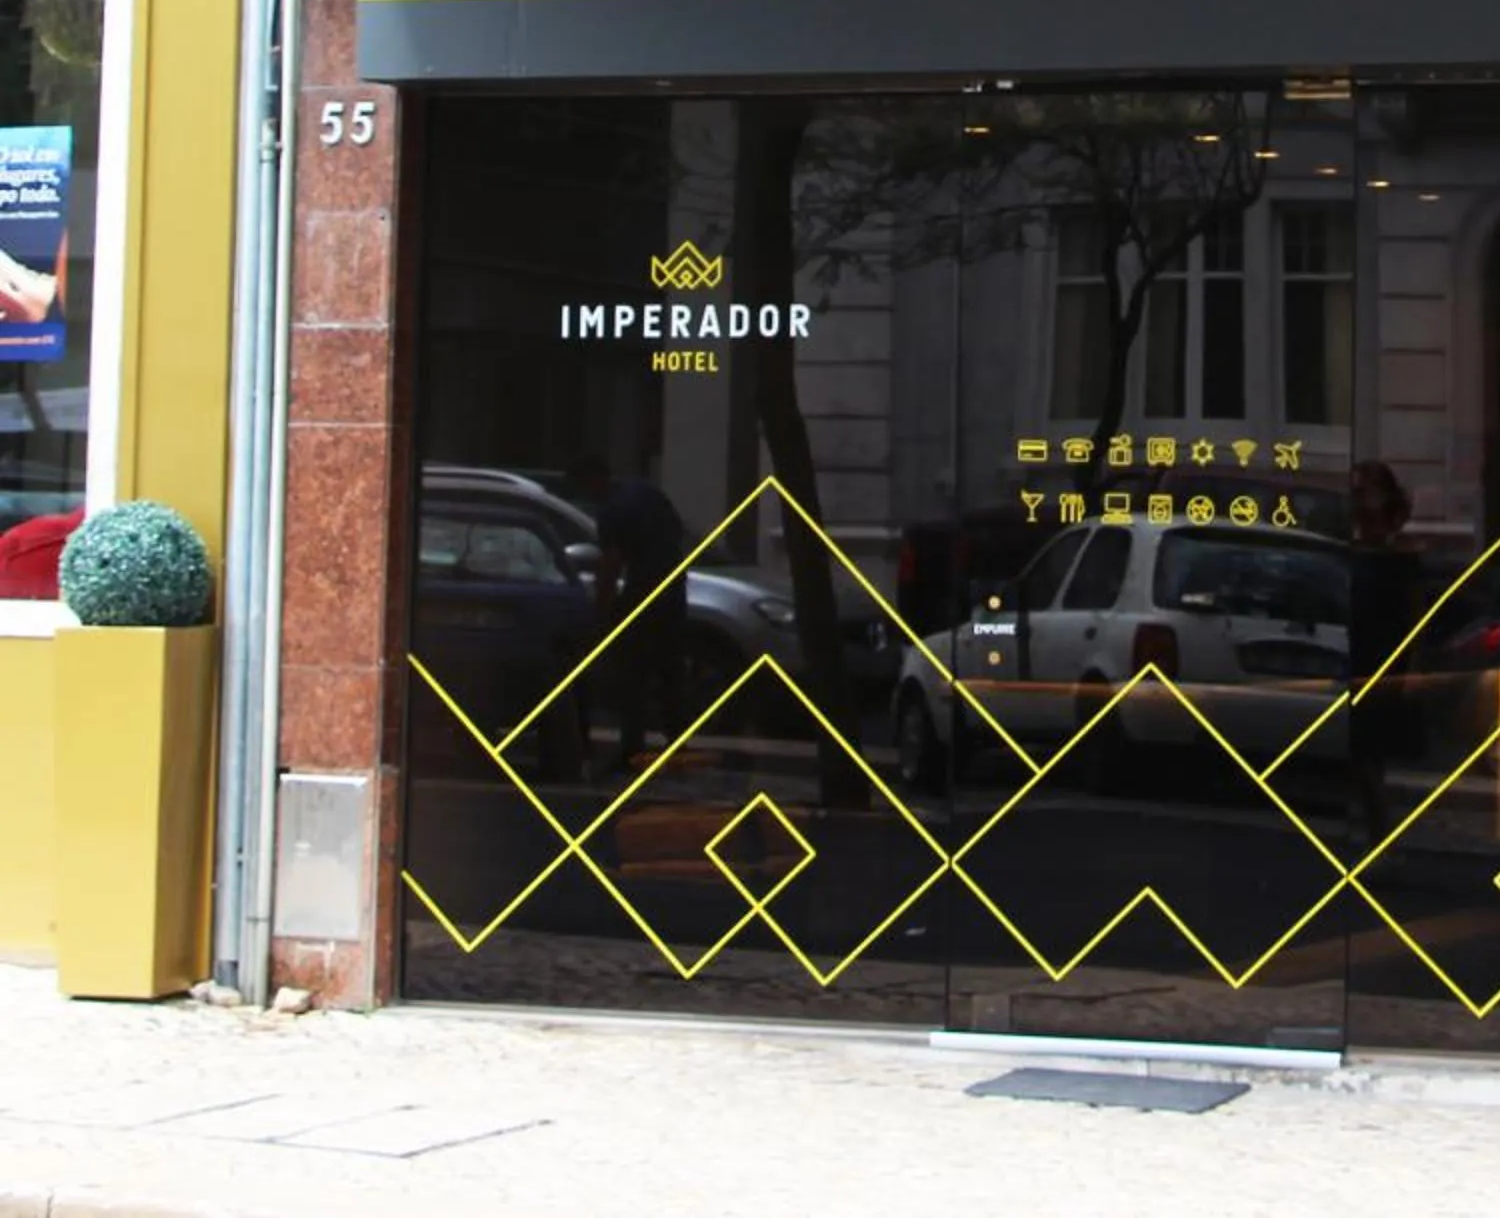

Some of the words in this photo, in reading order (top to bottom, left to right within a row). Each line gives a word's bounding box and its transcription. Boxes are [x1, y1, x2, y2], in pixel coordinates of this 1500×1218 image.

[319, 101, 376, 145] 55
[560, 303, 811, 339] IMPERADOR
[652, 351, 719, 372] HOTEL
